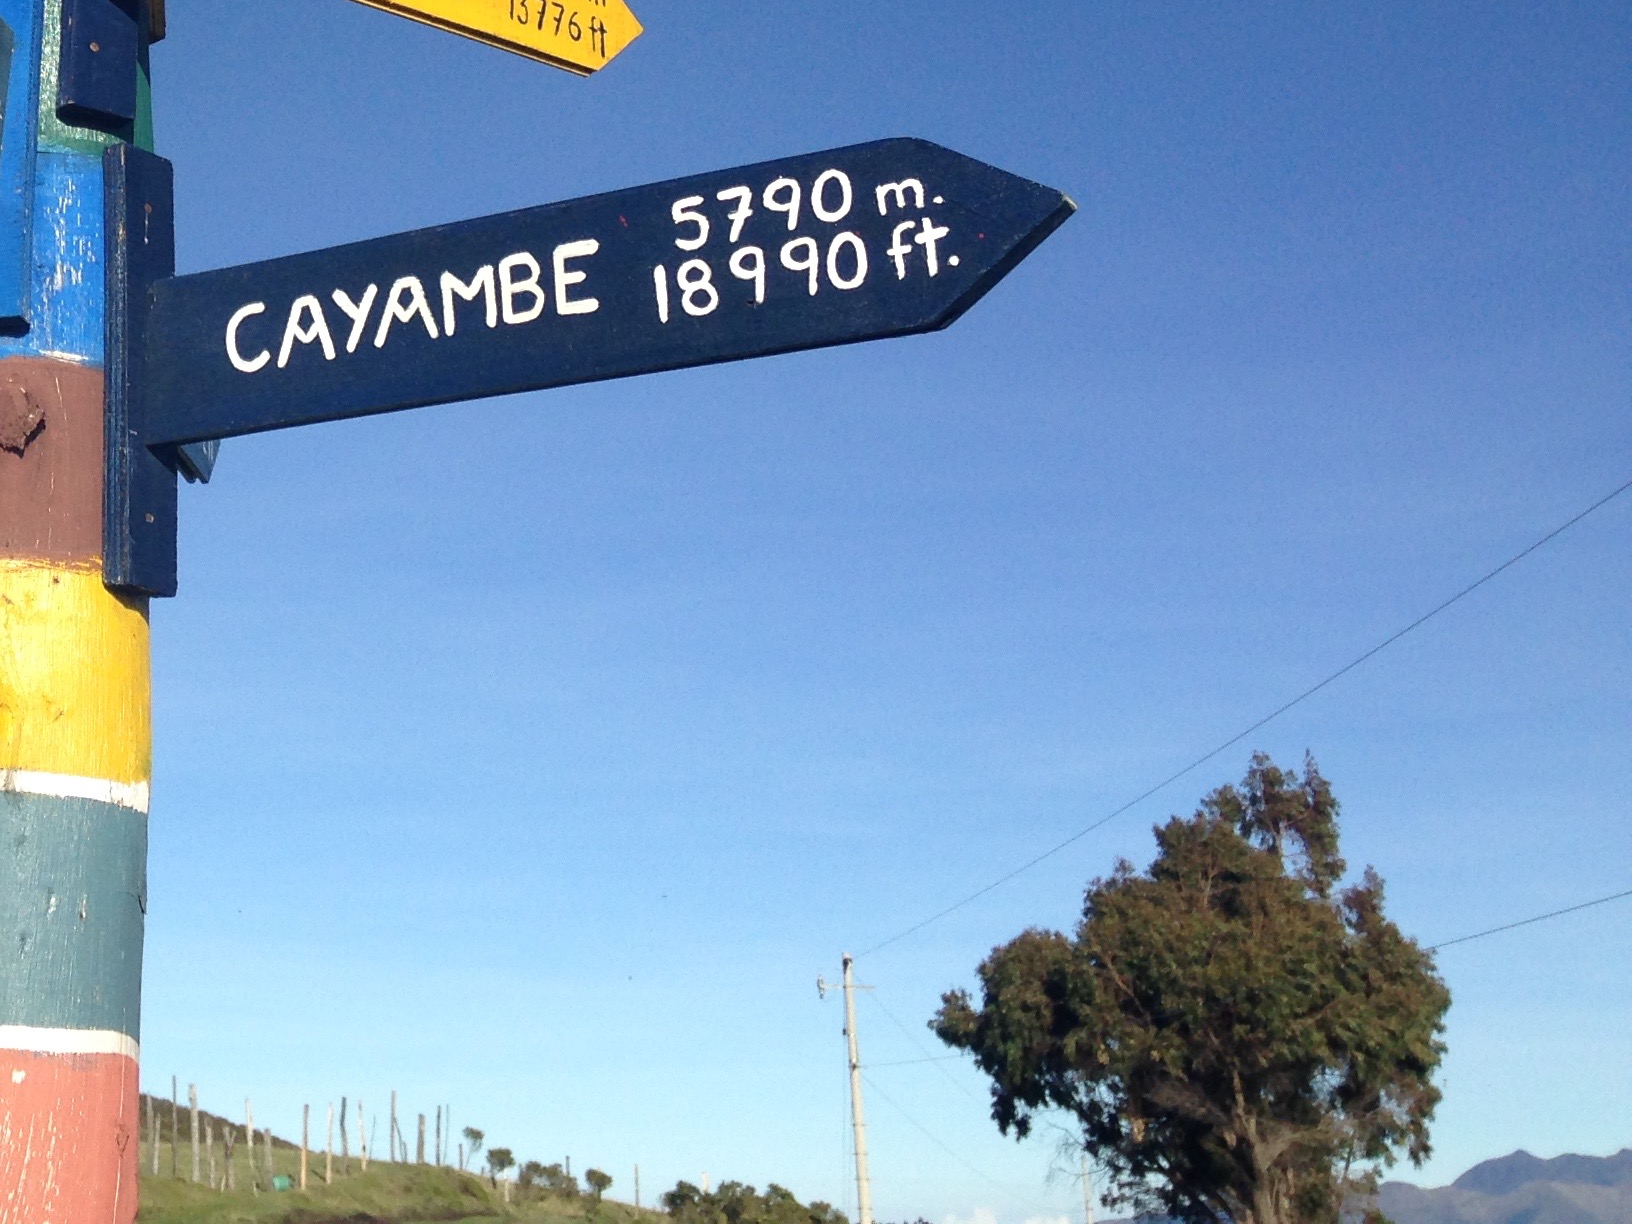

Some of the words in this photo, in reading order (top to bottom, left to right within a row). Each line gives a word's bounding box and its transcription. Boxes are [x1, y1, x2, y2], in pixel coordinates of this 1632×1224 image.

[671, 168, 852, 253] 5790
[224, 239, 600, 374] CAYAMBE
[652, 231, 868, 324] 18990
